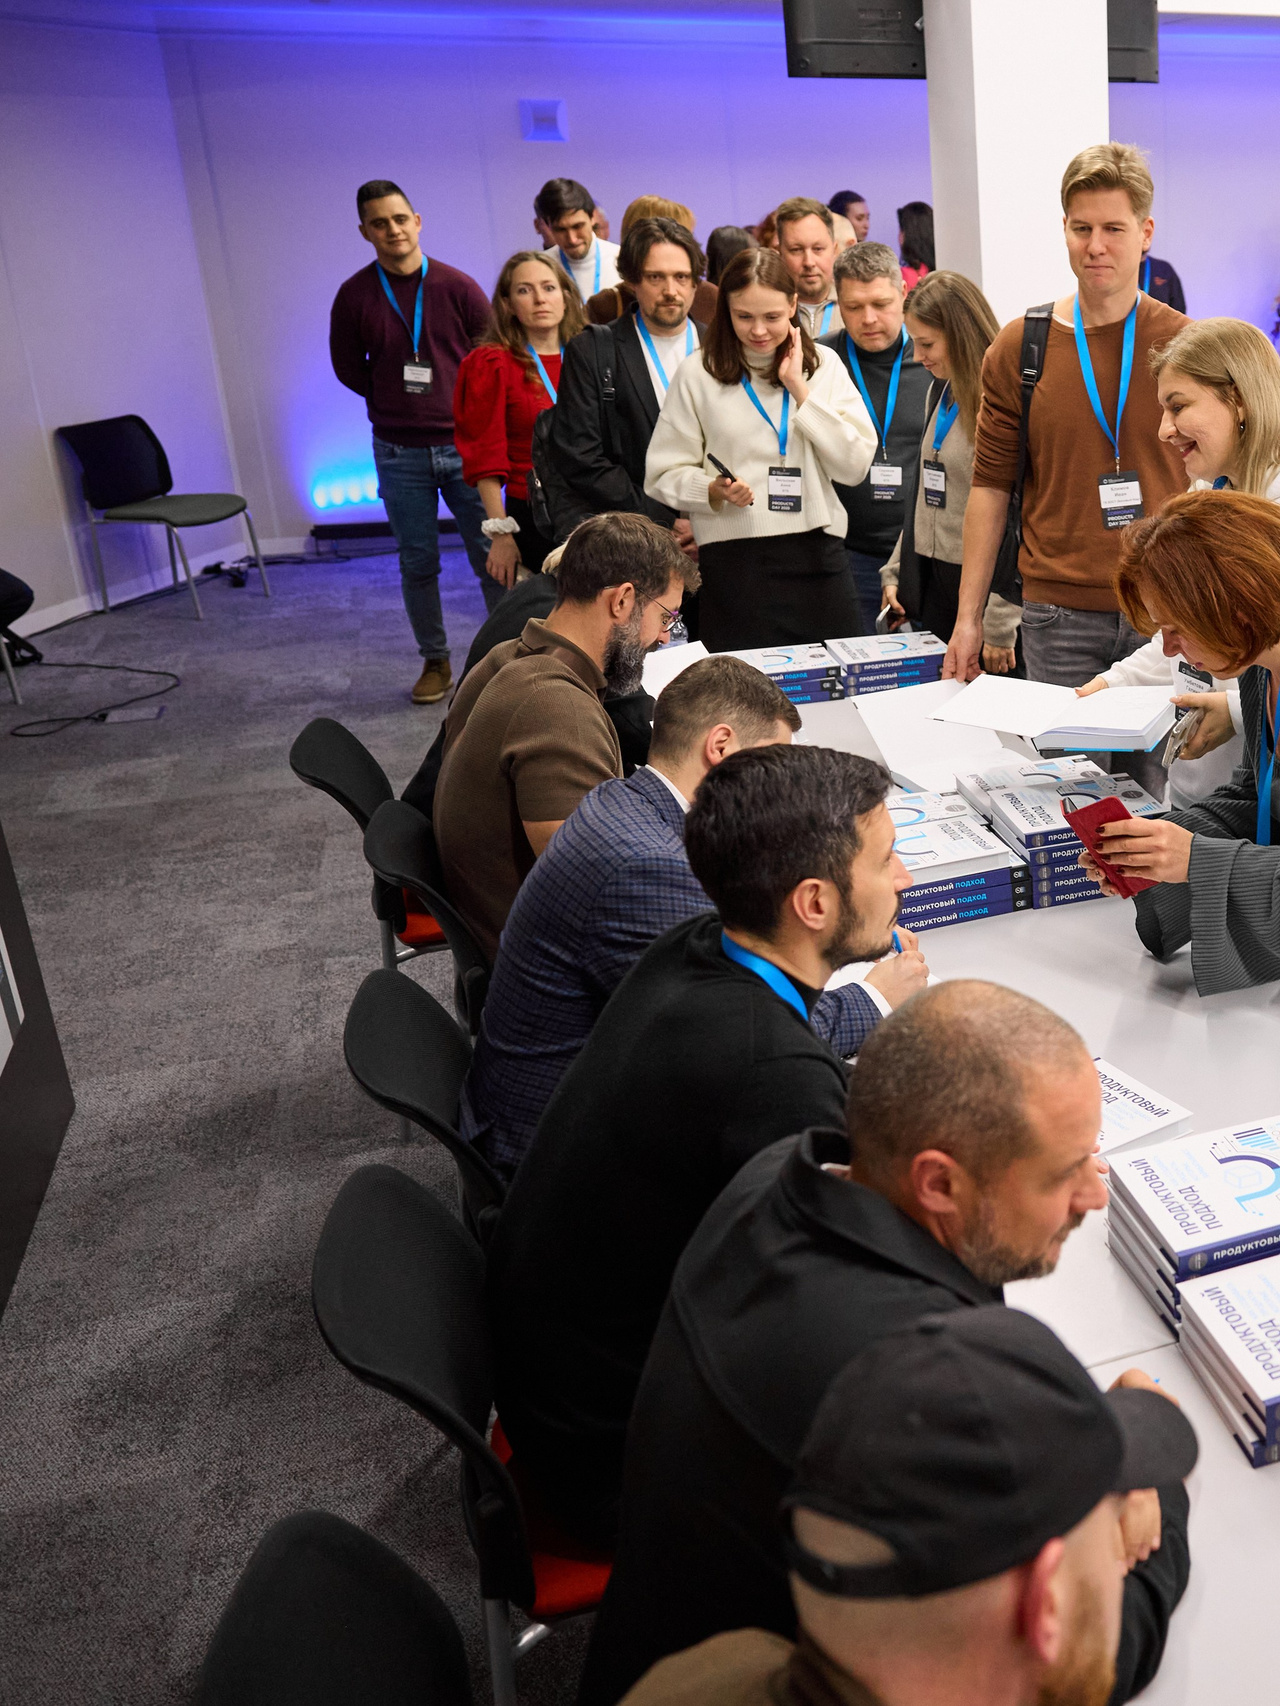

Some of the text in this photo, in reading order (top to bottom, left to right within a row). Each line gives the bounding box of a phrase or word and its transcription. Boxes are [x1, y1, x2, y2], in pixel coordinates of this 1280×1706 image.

[864, 660, 902, 670] ПРОДУКТОВЫЙ
[859, 672, 898, 682] ПРОДУКТОВЫЙ
[1048, 832, 1076, 841] ПРОДУК
[1052, 848, 1087, 858] ПРОДУКТО
[955, 878, 985, 888] ПОДХОД
[902, 893, 987, 914] ПРОДУКТОВЫЙ ПОДХОД
[905, 907, 988, 929] ПРОДУКТОВЫЙ ПОДХОД
[1128, 1158, 1201, 1235] ПРОДУКТОВЫЙ
[1178, 1185, 1223, 1229] ПОДХОД
